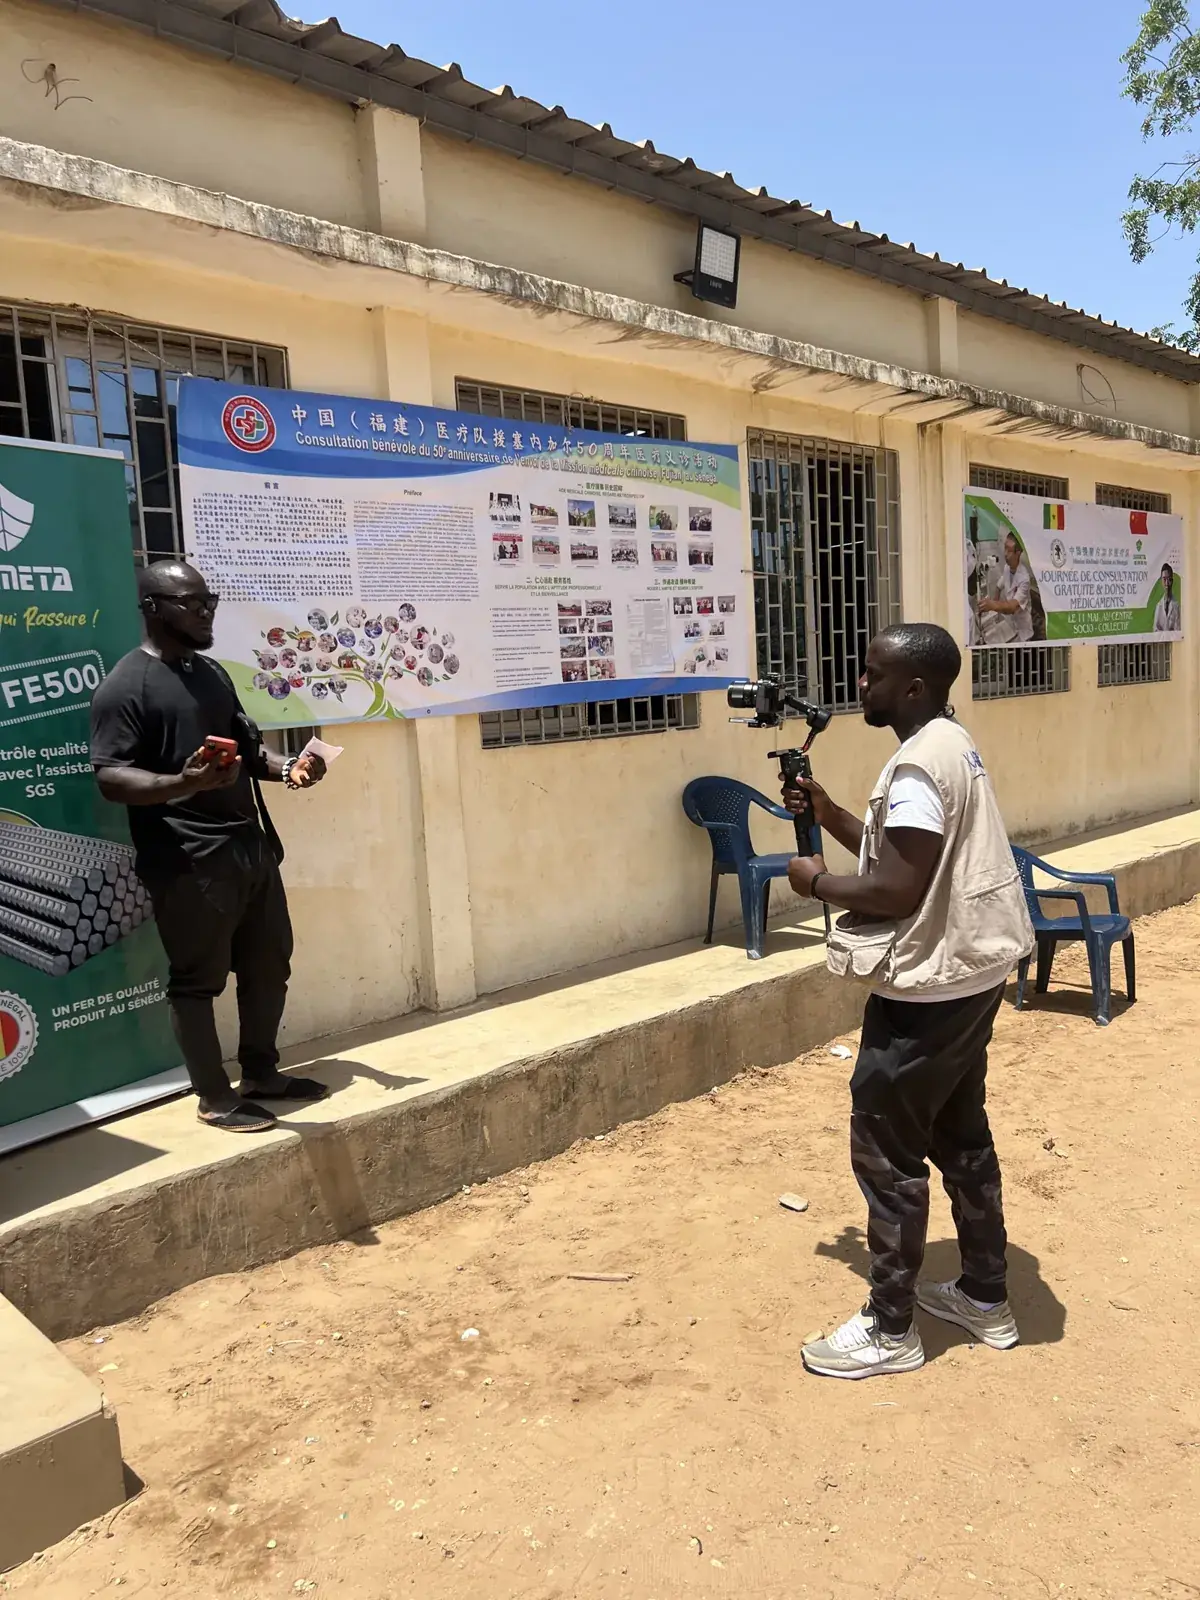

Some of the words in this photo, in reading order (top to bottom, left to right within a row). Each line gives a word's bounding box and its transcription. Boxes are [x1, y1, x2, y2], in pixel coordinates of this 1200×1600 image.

[295, 431, 369, 450] Consultation
[372, 437, 417, 454] bénévole
[418, 443, 431, 456] du
[448, 448, 501, 463] anniversaire
[502, 453, 514, 465] de
[541, 457, 550, 470] de
[551, 457, 560, 471] la
[560, 459, 587, 474] Mission
[589, 462, 624, 477] médicale
[626, 466, 657, 479] chinoise
[403, 489, 422, 497] Préface
[1039, 568, 1079, 583] JOURNÉE
[1080, 570, 1092, 582] DE
[1092, 570, 1148, 582] CONSULTATION
[1054, 583, 1095, 596] GRATUITE
[1095, 583, 1104, 595] &
[1104, 583, 1125, 594] DONS
[1126, 583, 1137, 594] DE
[23, 605, 87, 634] Rassure
[92, 608, 100, 628] !
[1068, 612, 1075, 623] LE
[1073, 623, 1094, 634] SOCIO
[1098, 621, 1129, 632] COLLECTIF
[1, 663, 100, 709] FE500
[40, 741, 89, 760] qualité
[0, 768, 34, 781] avec
[25, 782, 56, 798] SGS
[52, 1004, 71, 1018] UN
[72, 998, 96, 1012] FER
[97, 992, 114, 1006] DE
[115, 977, 160, 1001] QUALITÉ
[54, 1008, 106, 1032] PRODUIT
[109, 1003, 126, 1016] AU
[127, 988, 169, 1011] SÉNÉGA
[8, 1045, 29, 1067] 100%
